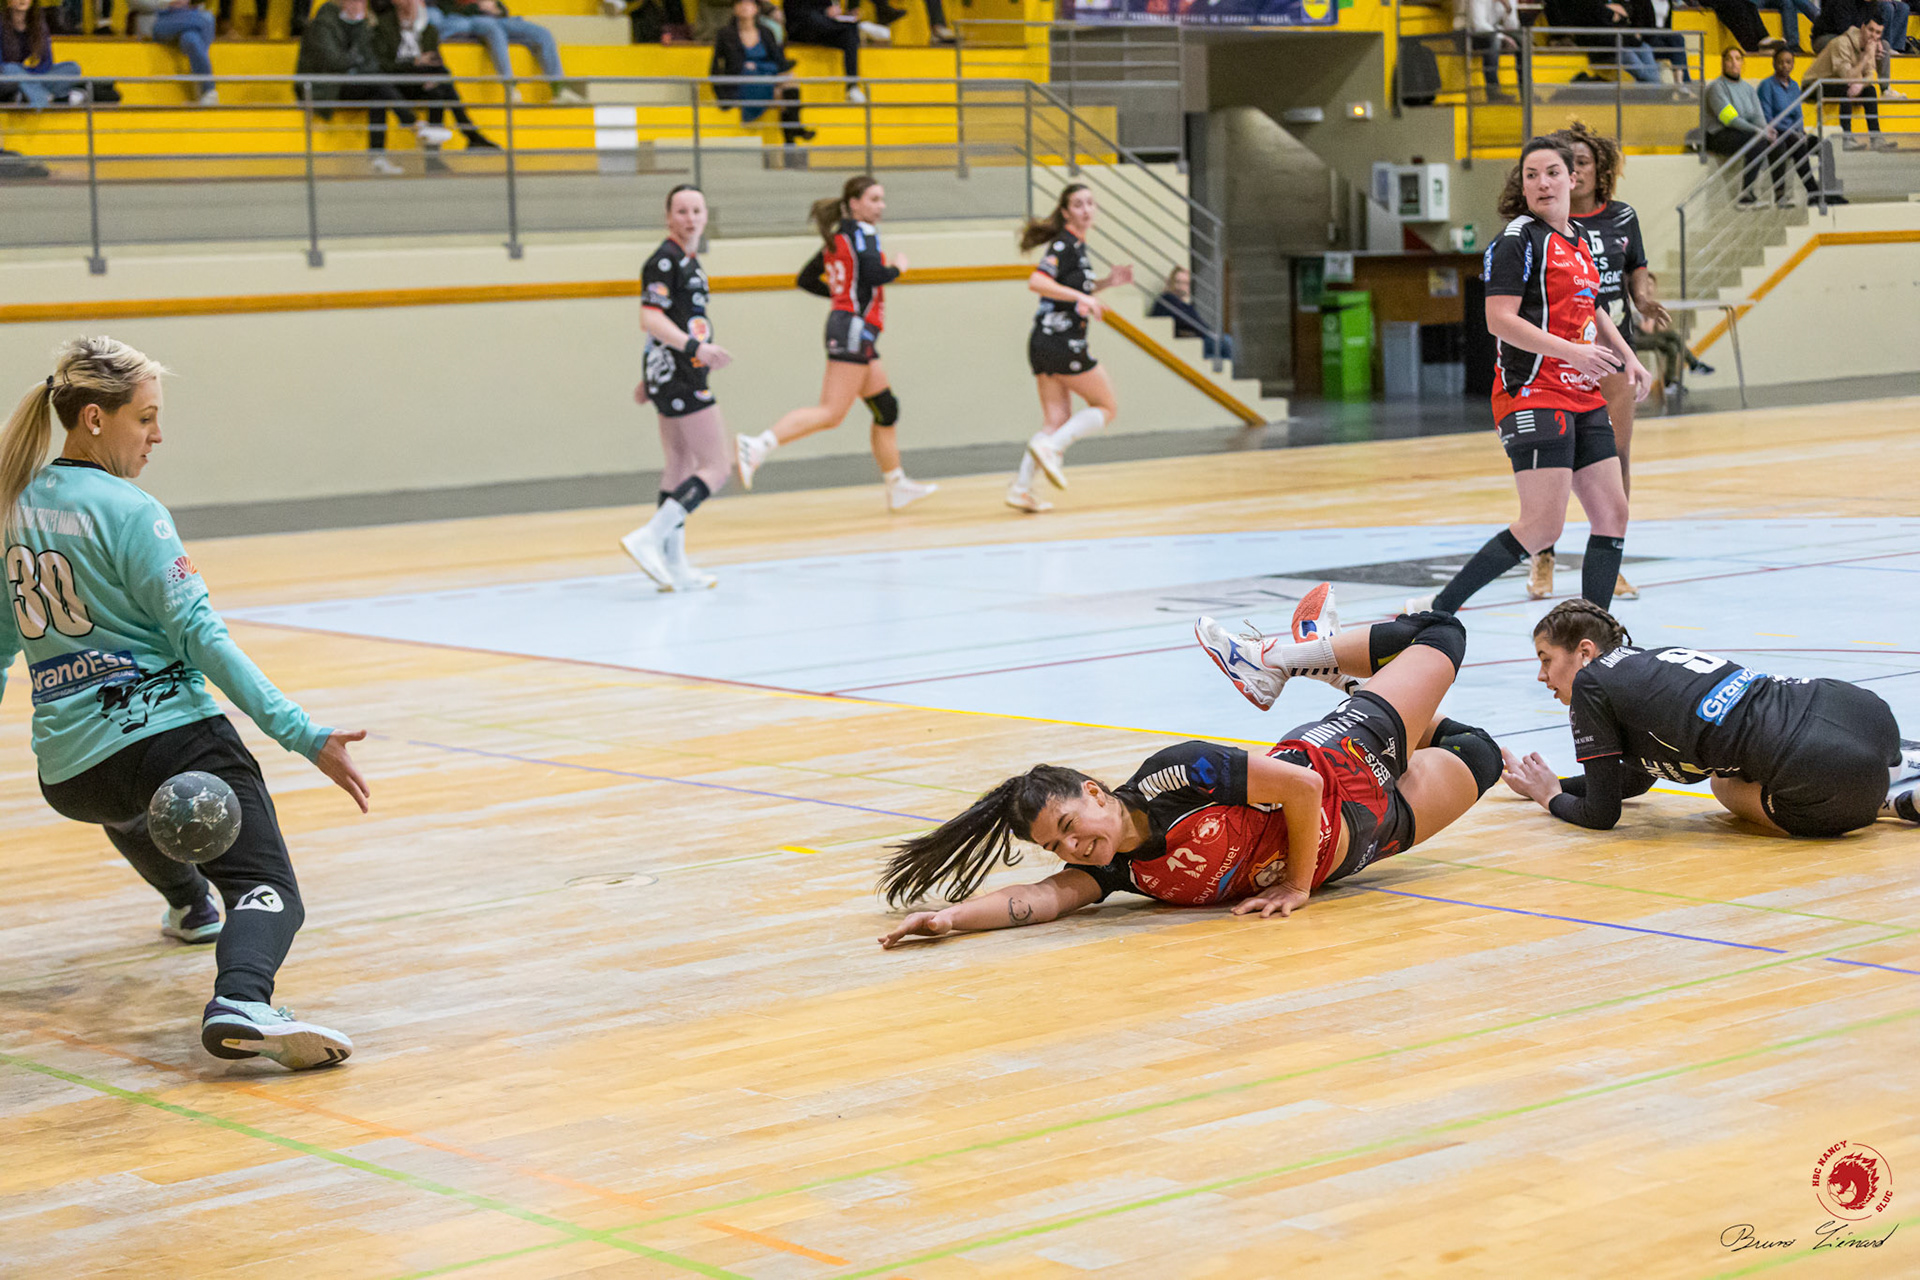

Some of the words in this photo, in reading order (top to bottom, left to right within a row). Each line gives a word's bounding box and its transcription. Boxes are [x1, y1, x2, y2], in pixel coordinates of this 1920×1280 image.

[5, 543, 95, 640] 30
[1166, 847, 1208, 879] 13
[1210, 845, 1241, 887] Hoquet
